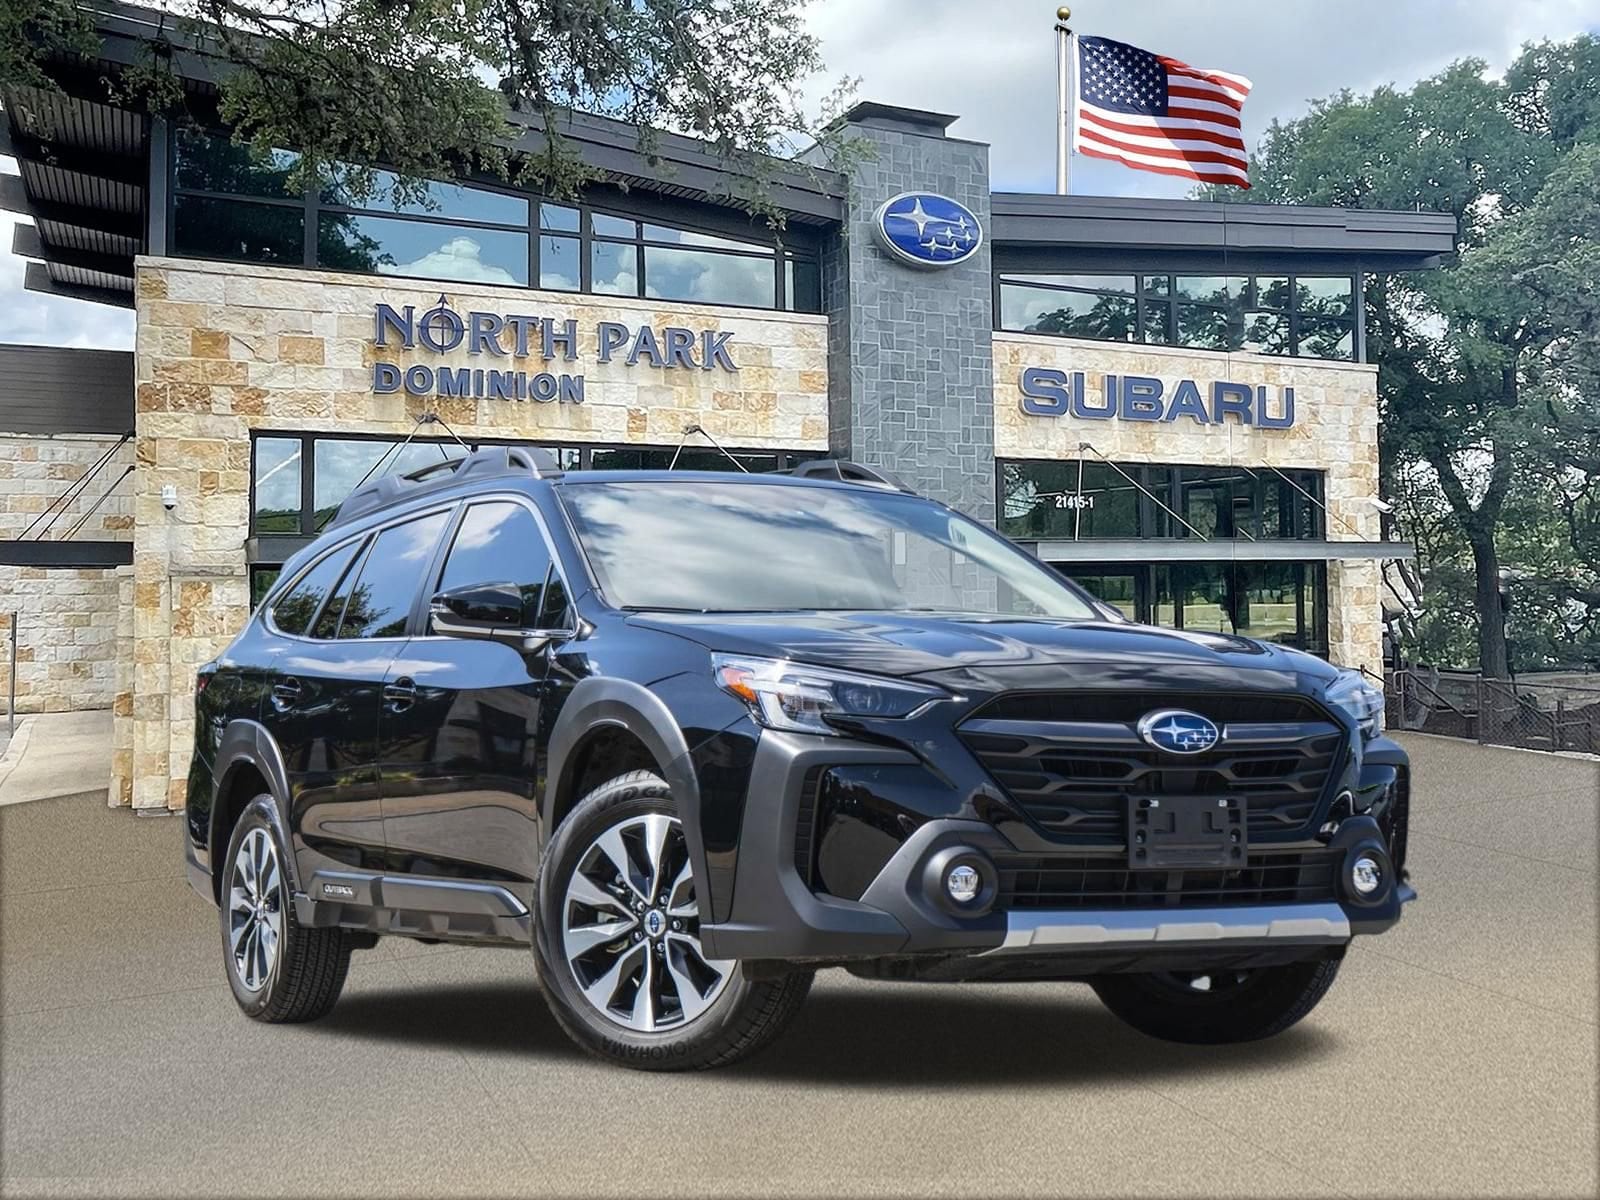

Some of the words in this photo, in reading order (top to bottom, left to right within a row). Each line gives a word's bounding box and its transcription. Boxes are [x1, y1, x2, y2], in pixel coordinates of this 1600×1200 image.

[375, 294, 580, 362] NORTH
[597, 321, 742, 373] PARK
[373, 362, 585, 404] DOMINION
[1019, 367, 1295, 430] SUBARU
